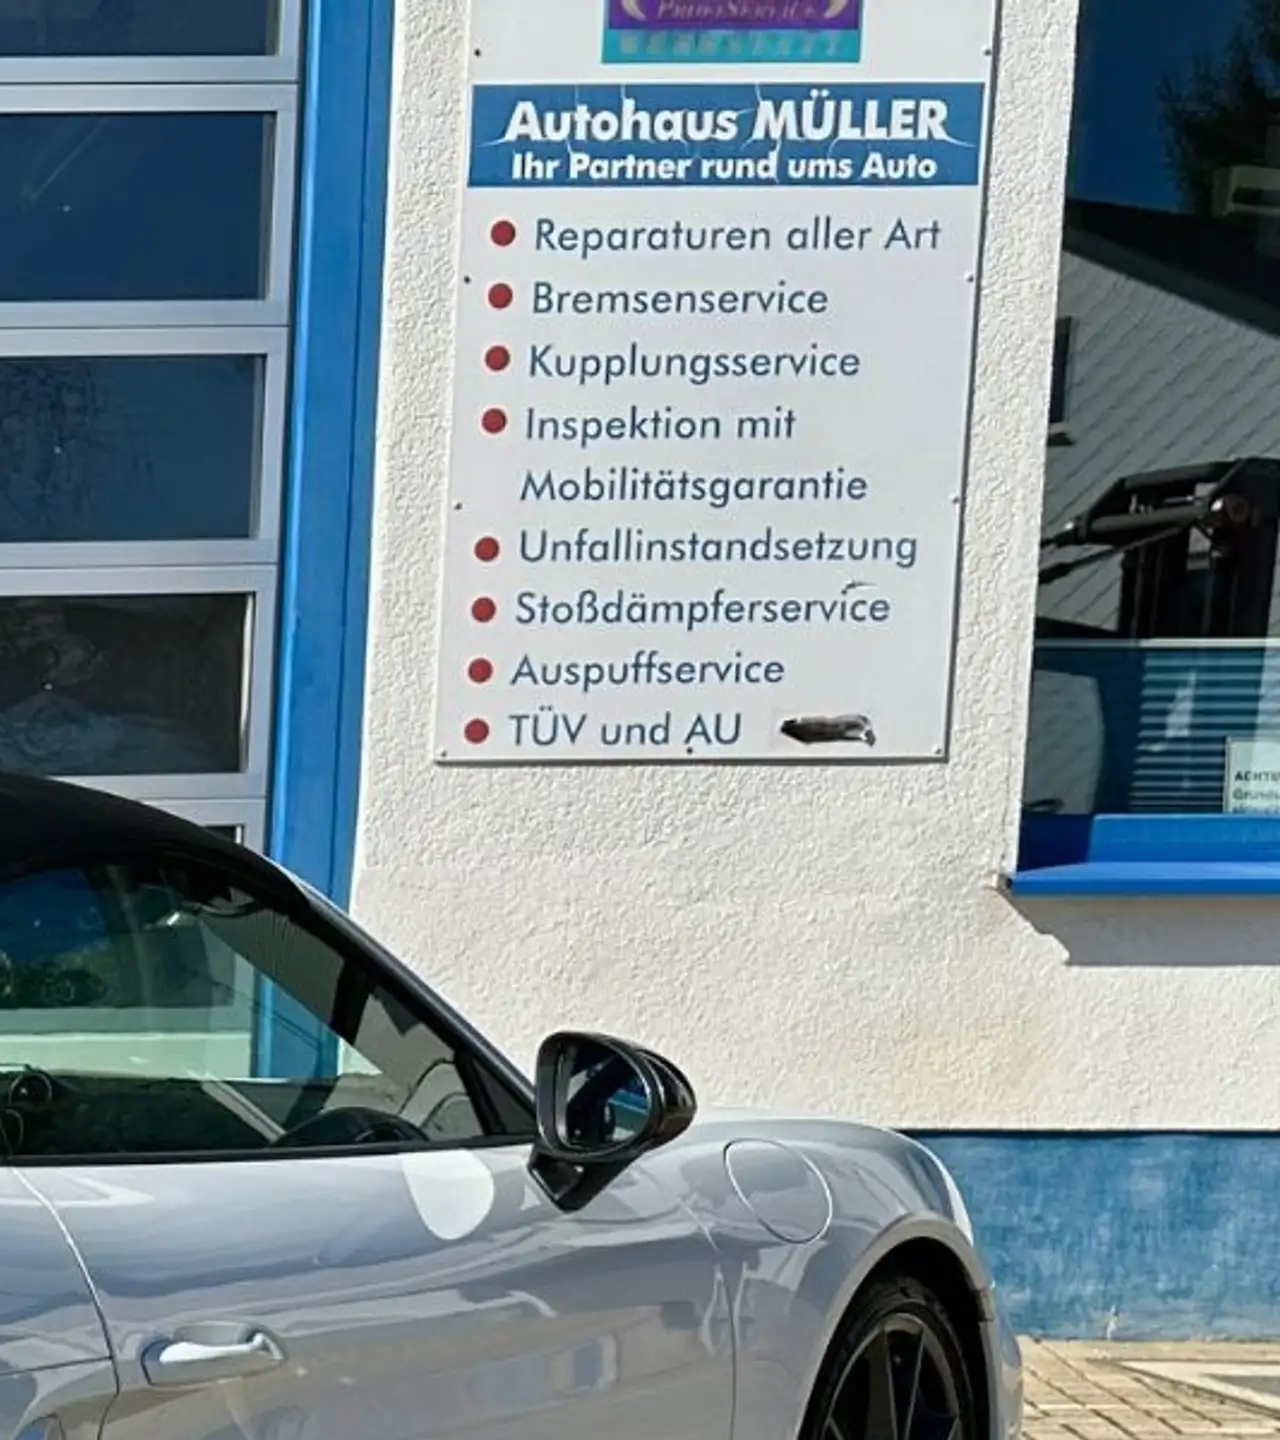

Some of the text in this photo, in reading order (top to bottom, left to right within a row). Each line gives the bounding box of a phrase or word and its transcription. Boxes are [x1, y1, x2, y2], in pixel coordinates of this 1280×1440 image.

[503, 89, 948, 141] Autohaus MÜLLER
[512, 153, 937, 180] Ihr Partner rund ums Auto
[535, 216, 941, 258] Reparaturen aller Art
[532, 280, 828, 314] Bremsenservice
[529, 343, 861, 385] Kupplungsservice
[525, 407, 796, 447] Inspektion mit
[520, 467, 868, 508] Mobilitätsgarantie
[519, 528, 917, 568] Unfallinstandsetzung
[515, 590, 890, 630] Stoßdämpferservice
[510, 650, 785, 691] Auspuffservice
[509, 705, 742, 746] TÜV und AU
[1235, 770, 1280, 782] ACHTU
